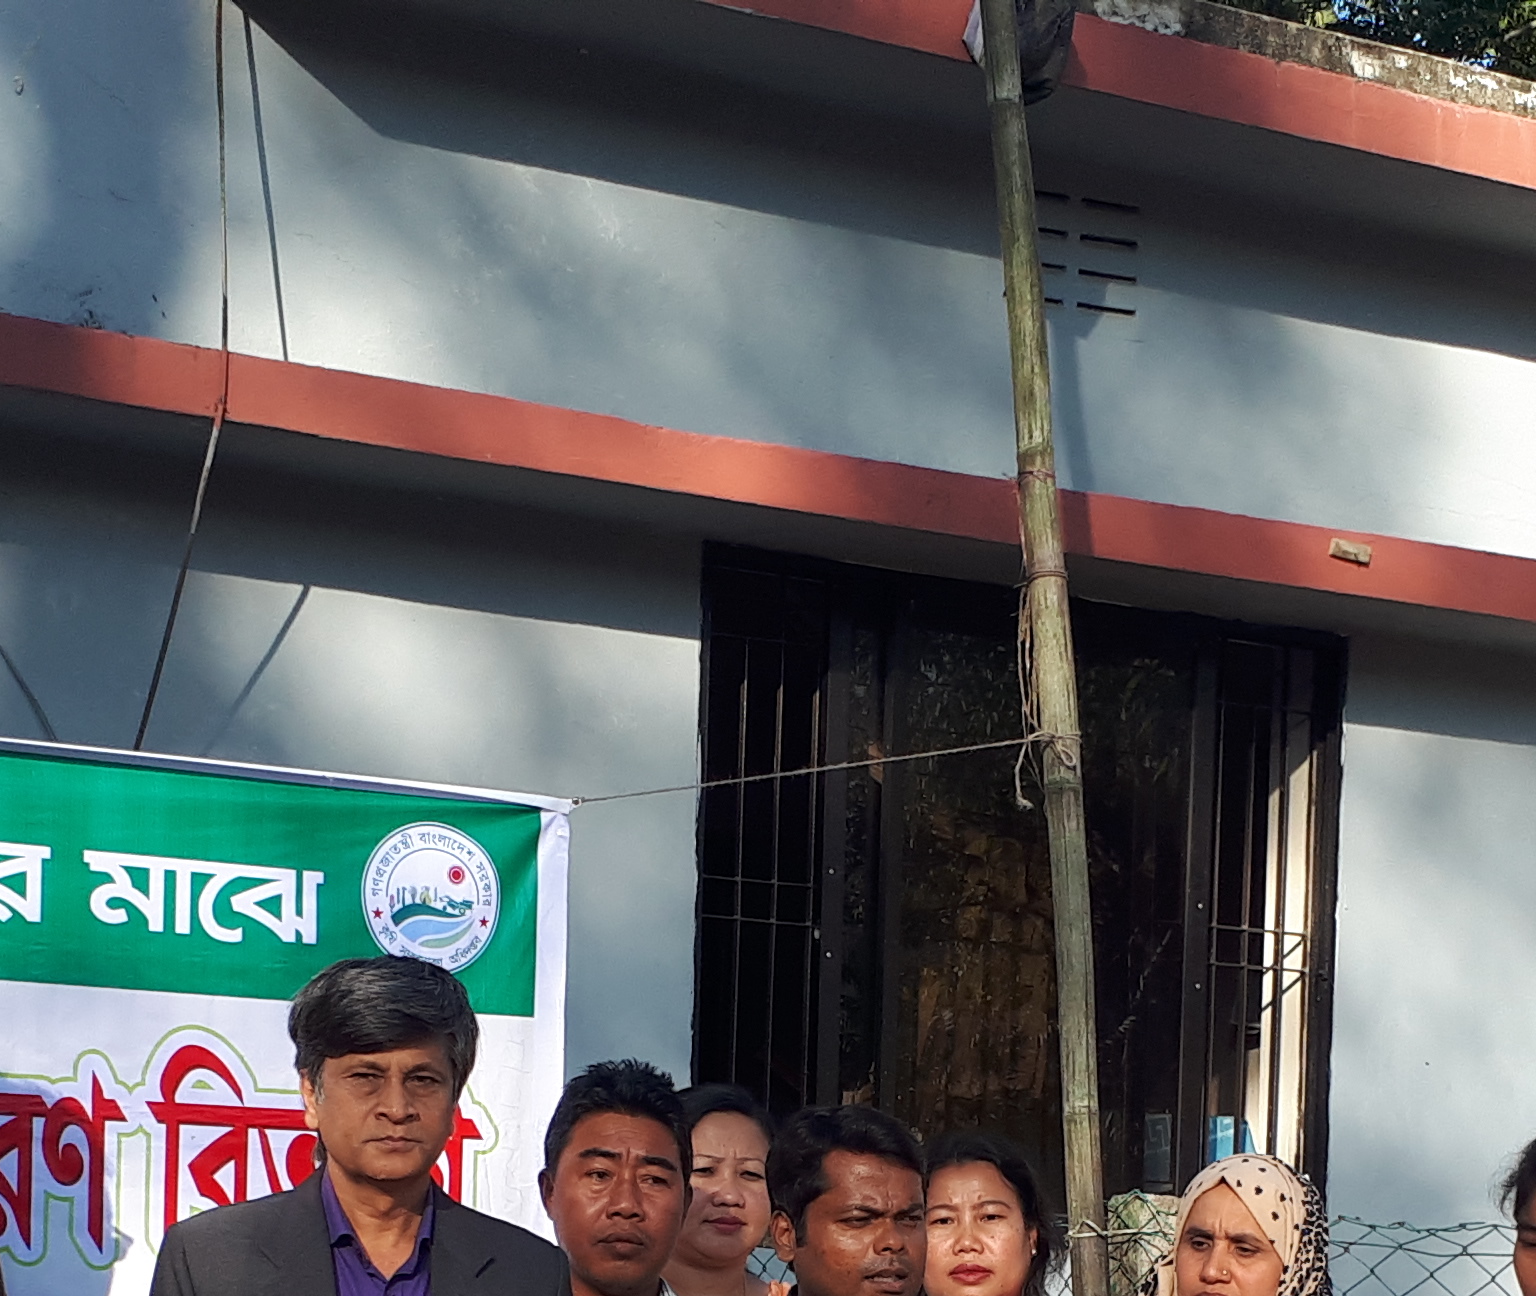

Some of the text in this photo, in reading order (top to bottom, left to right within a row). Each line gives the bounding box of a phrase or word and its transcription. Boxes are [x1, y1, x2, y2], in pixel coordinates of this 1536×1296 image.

[81, 847, 325, 946] মাঝে
[417, 831, 476, 862] বাংলাদেশ
[476, 861, 493, 907] সরকার
